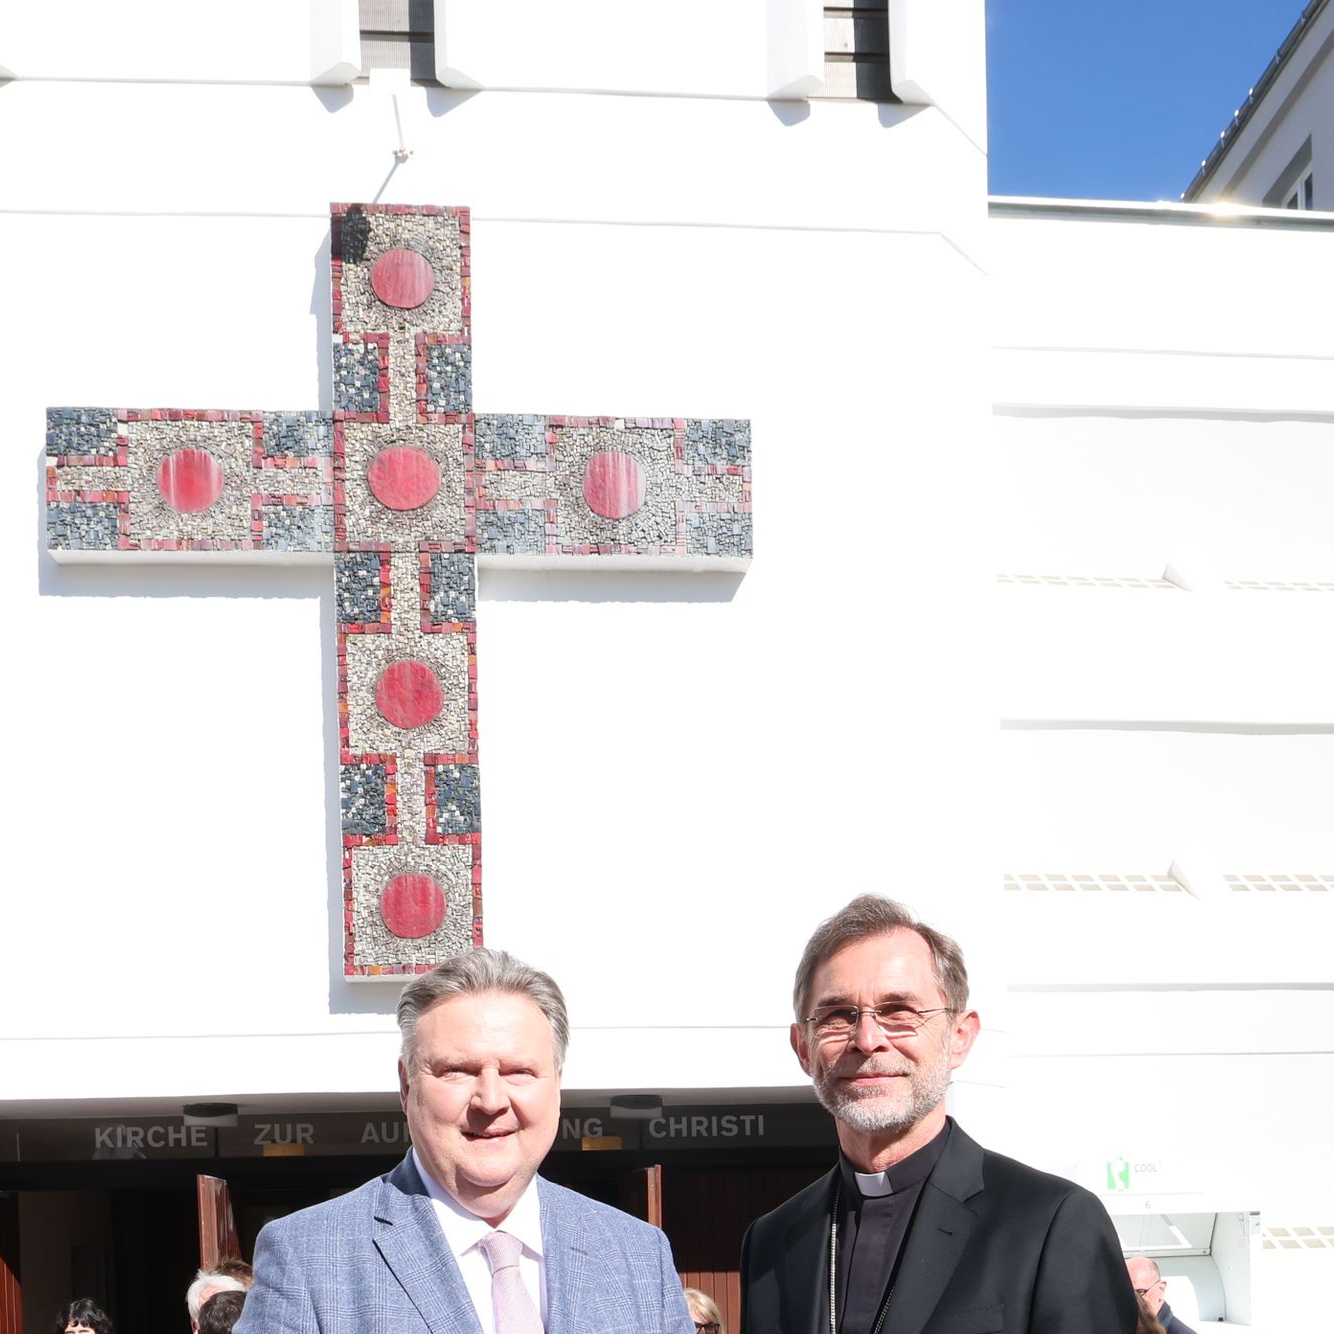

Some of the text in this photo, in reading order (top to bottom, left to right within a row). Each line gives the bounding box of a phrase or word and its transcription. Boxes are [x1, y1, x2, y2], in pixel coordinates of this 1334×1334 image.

[94, 1125, 208, 1149] KIRCHE
[254, 1123, 315, 1146] ZUR
[649, 1115, 765, 1138] CHRISTI
